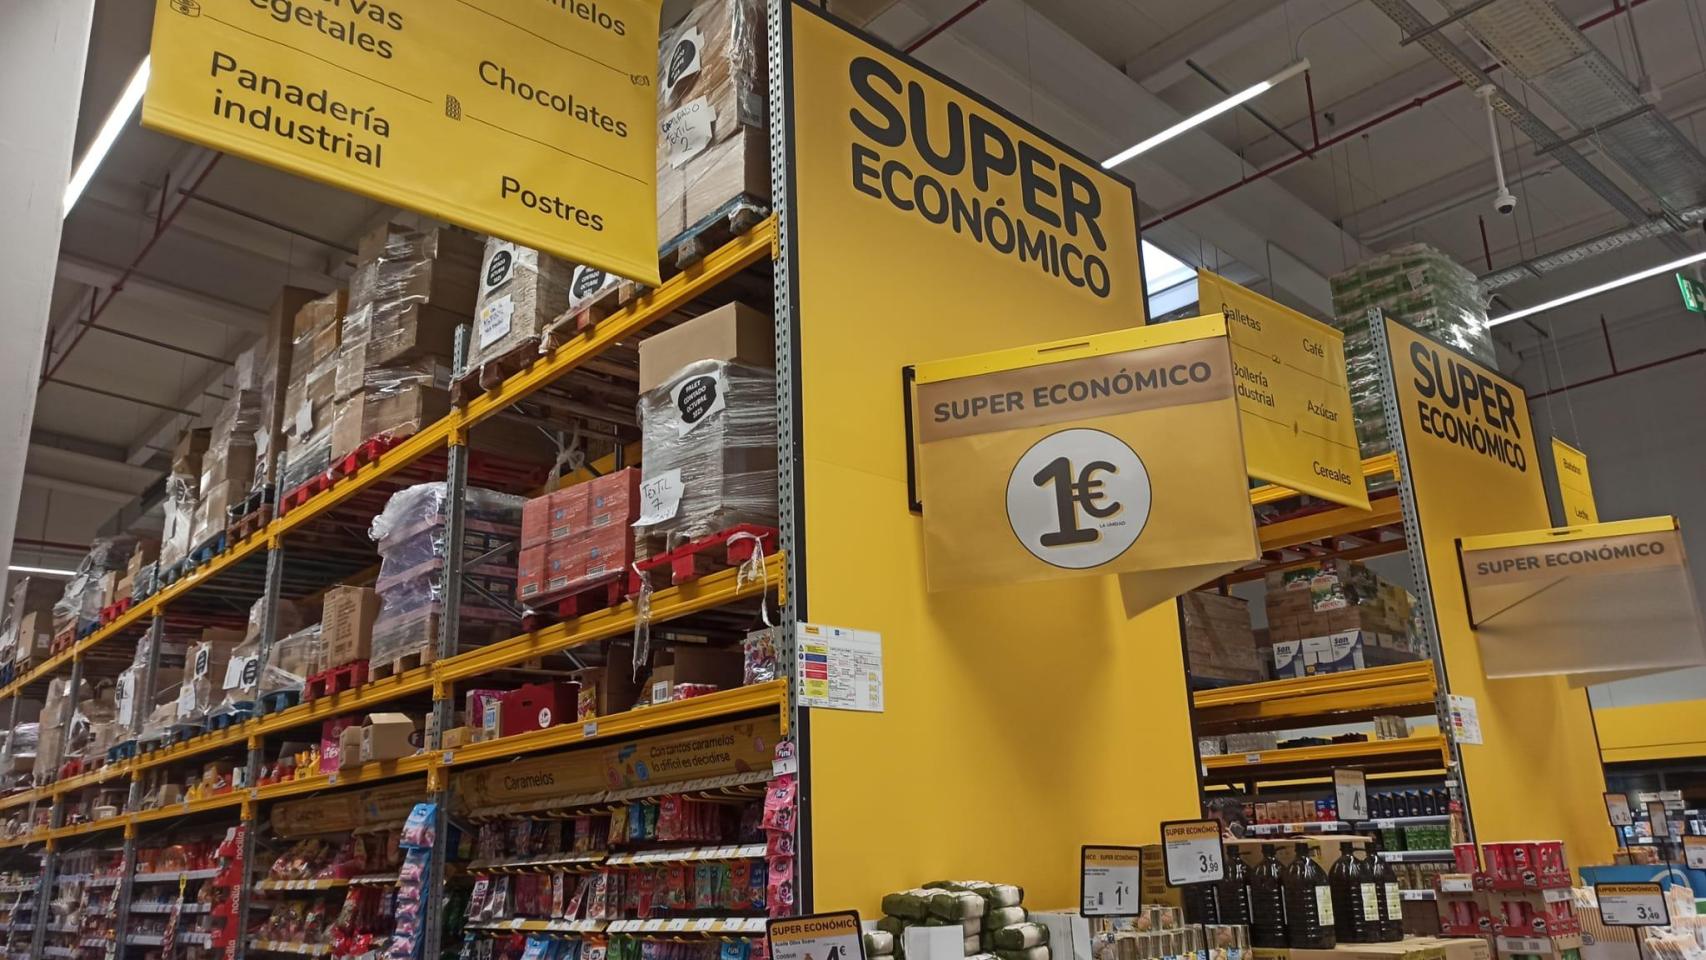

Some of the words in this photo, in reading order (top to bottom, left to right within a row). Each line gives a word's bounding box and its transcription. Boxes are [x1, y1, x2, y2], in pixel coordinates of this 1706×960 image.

[211, 50, 390, 138] Panadería
[478, 60, 627, 138] Chocolates
[213, 89, 382, 168] industrial
[681, 136, 692, 153] 2
[849, 56, 1107, 251] SUPER
[501, 175, 604, 231] Postres
[851, 142, 1110, 298] ECONÓMICO
[1222, 303, 1262, 332] Galletas
[1302, 338, 1325, 358] Café
[934, 390, 1025, 423] SUPER
[1032, 361, 1212, 408] ECONÓMICO
[1235, 382, 1275, 408] dustrial
[1410, 341, 1521, 439] SUPER
[1307, 399, 1339, 422] Azúcar
[1417, 400, 1527, 473] ECONÓMICO
[1313, 460, 1352, 486] Cereales
[652, 498, 663, 511] 7
[1477, 555, 1540, 576] SUPER
[1546, 541, 1665, 568] ECONÓMICO
[504, 770, 554, 791] Caramelos
[1166, 826, 1185, 836] SUPER
[772, 924, 802, 936] SUPER
